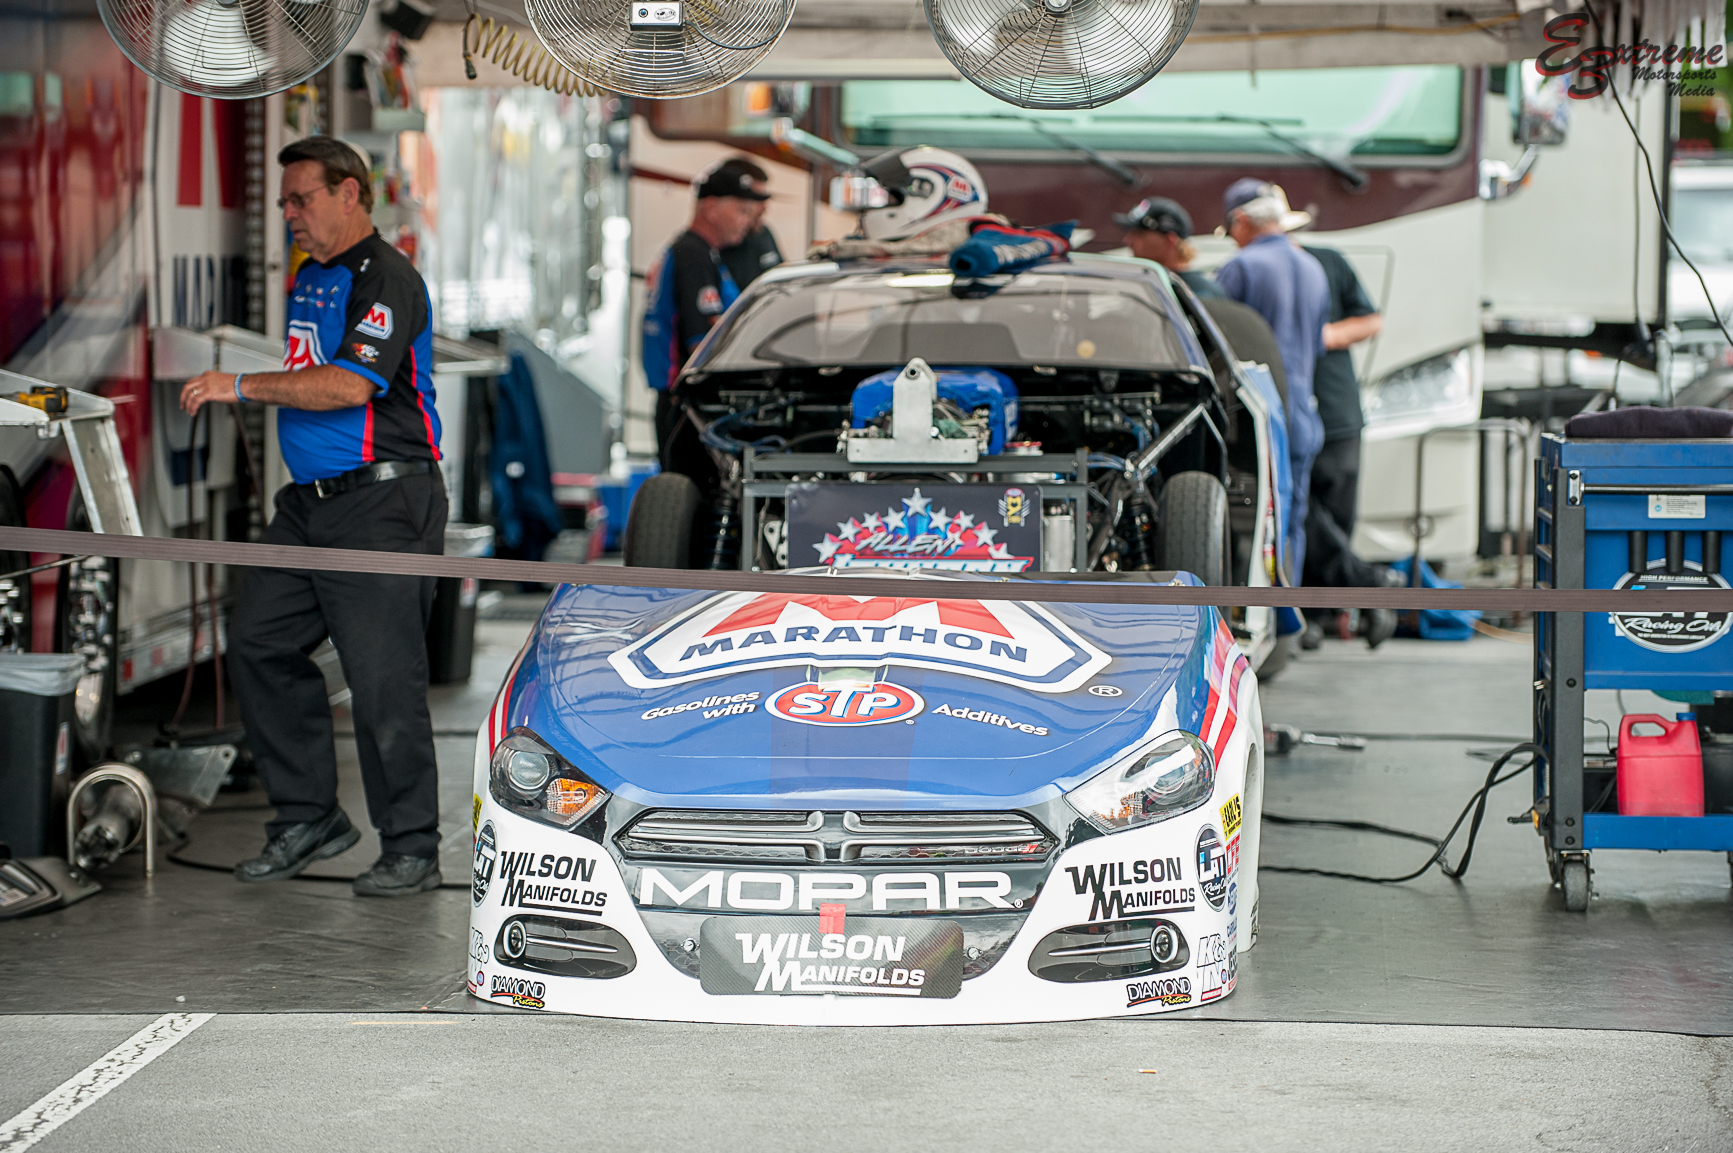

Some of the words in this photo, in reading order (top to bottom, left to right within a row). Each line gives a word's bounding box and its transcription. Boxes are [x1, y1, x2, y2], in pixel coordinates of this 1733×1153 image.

[855, 531, 957, 555] ALLEN
[1658, 574, 1709, 583] PERFORMANCE
[1624, 617, 1685, 634] Racing
[1685, 619, 1722, 632] Oils
[679, 624, 1028, 662] MARATHON
[641, 691, 761, 721] Gasolines
[702, 701, 756, 720] with
[788, 687, 901, 719] STP
[932, 703, 1049, 736] Additives
[500, 851, 597, 882] WILSON
[1064, 857, 1182, 895] WILSON
[501, 879, 608, 908] MANIFOLDS
[639, 868, 1017, 911] MOPAR
[1088, 887, 1196, 921] MANIFOLDS
[735, 932, 906, 964] WILSON
[491, 975, 546, 999] DIAMOND
[754, 961, 926, 992] MANIFOLDS
[1127, 977, 1192, 1000] DIAMOND
[512, 994, 545, 1008] Pistons
[1161, 994, 1191, 1007] Pistons
